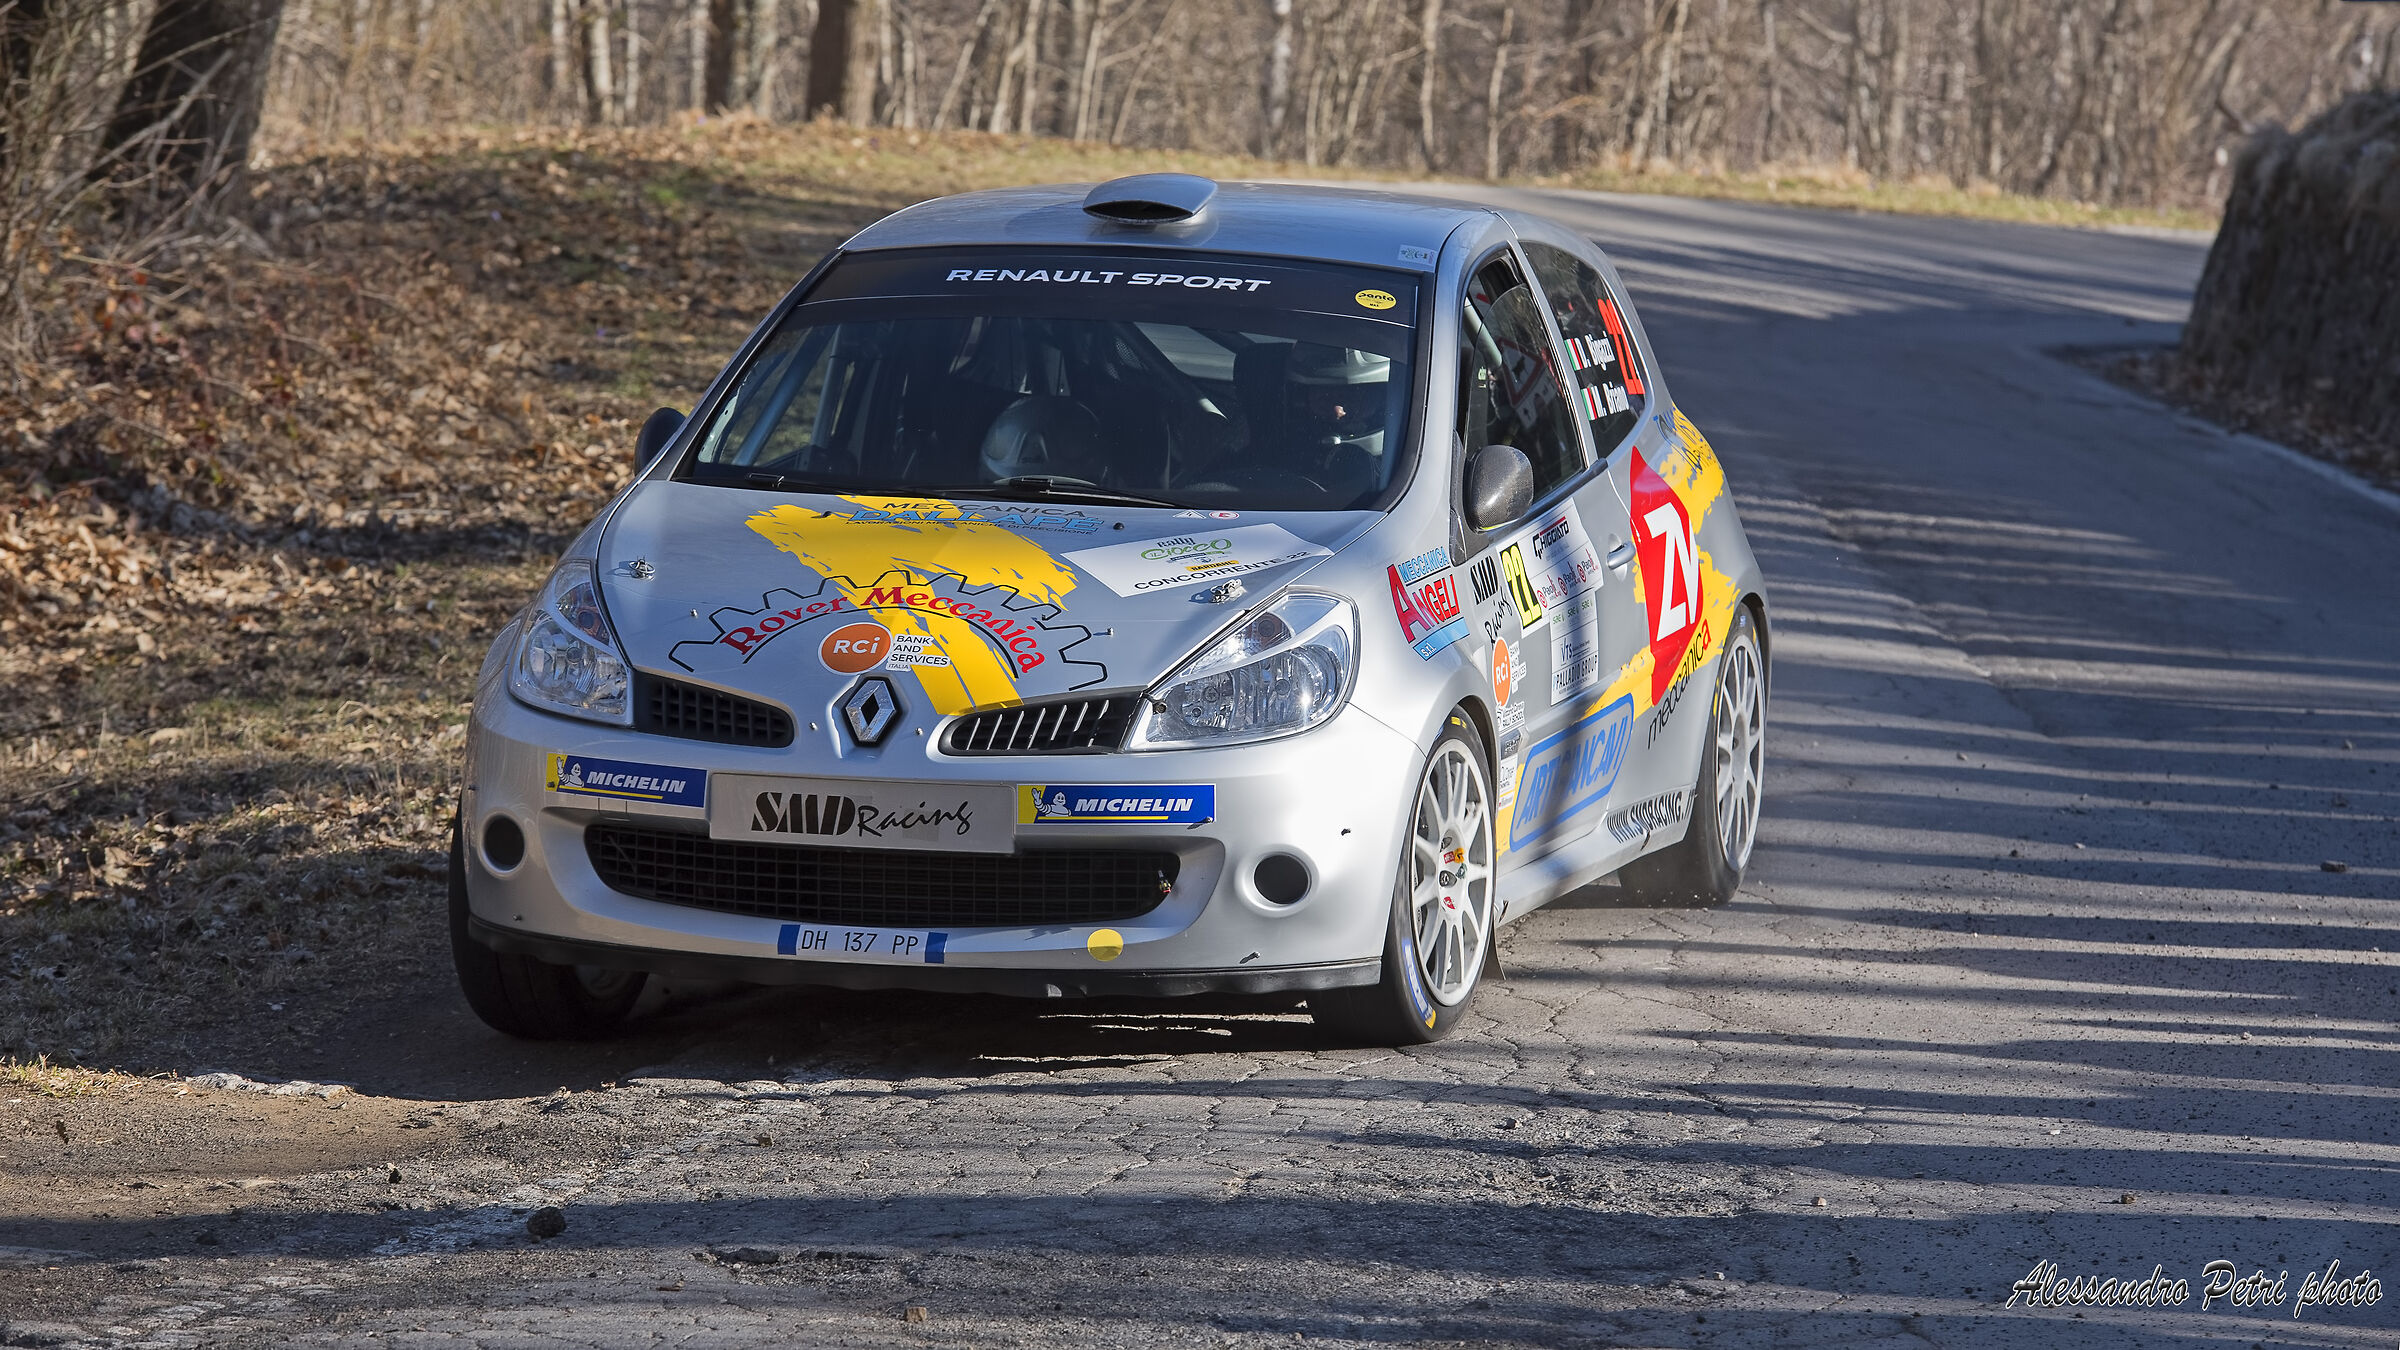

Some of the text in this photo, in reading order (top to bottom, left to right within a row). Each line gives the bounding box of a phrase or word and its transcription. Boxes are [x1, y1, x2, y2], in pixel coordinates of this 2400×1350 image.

[946, 268, 1272, 292] RENAULT SPORT
[882, 502, 1087, 518] MECCANICA
[1134, 558, 1285, 590] CONCORRENTE
[1397, 546, 1450, 583] MECCANICA
[1500, 543, 1542, 629] 22
[1386, 563, 1461, 644] ANGELI
[720, 586, 1046, 674] Rover Meccanica
[896, 635, 932, 645] BANK
[890, 654, 949, 666] SERVICES
[893, 645, 922, 653] AND
[1647, 619, 1711, 750] meccanica
[586, 771, 687, 794] MICHELIN
[751, 790, 973, 839] SMD Racing
[1073, 797, 1195, 813] MICHELIN
[801, 930, 919, 956] DH 137 PP
